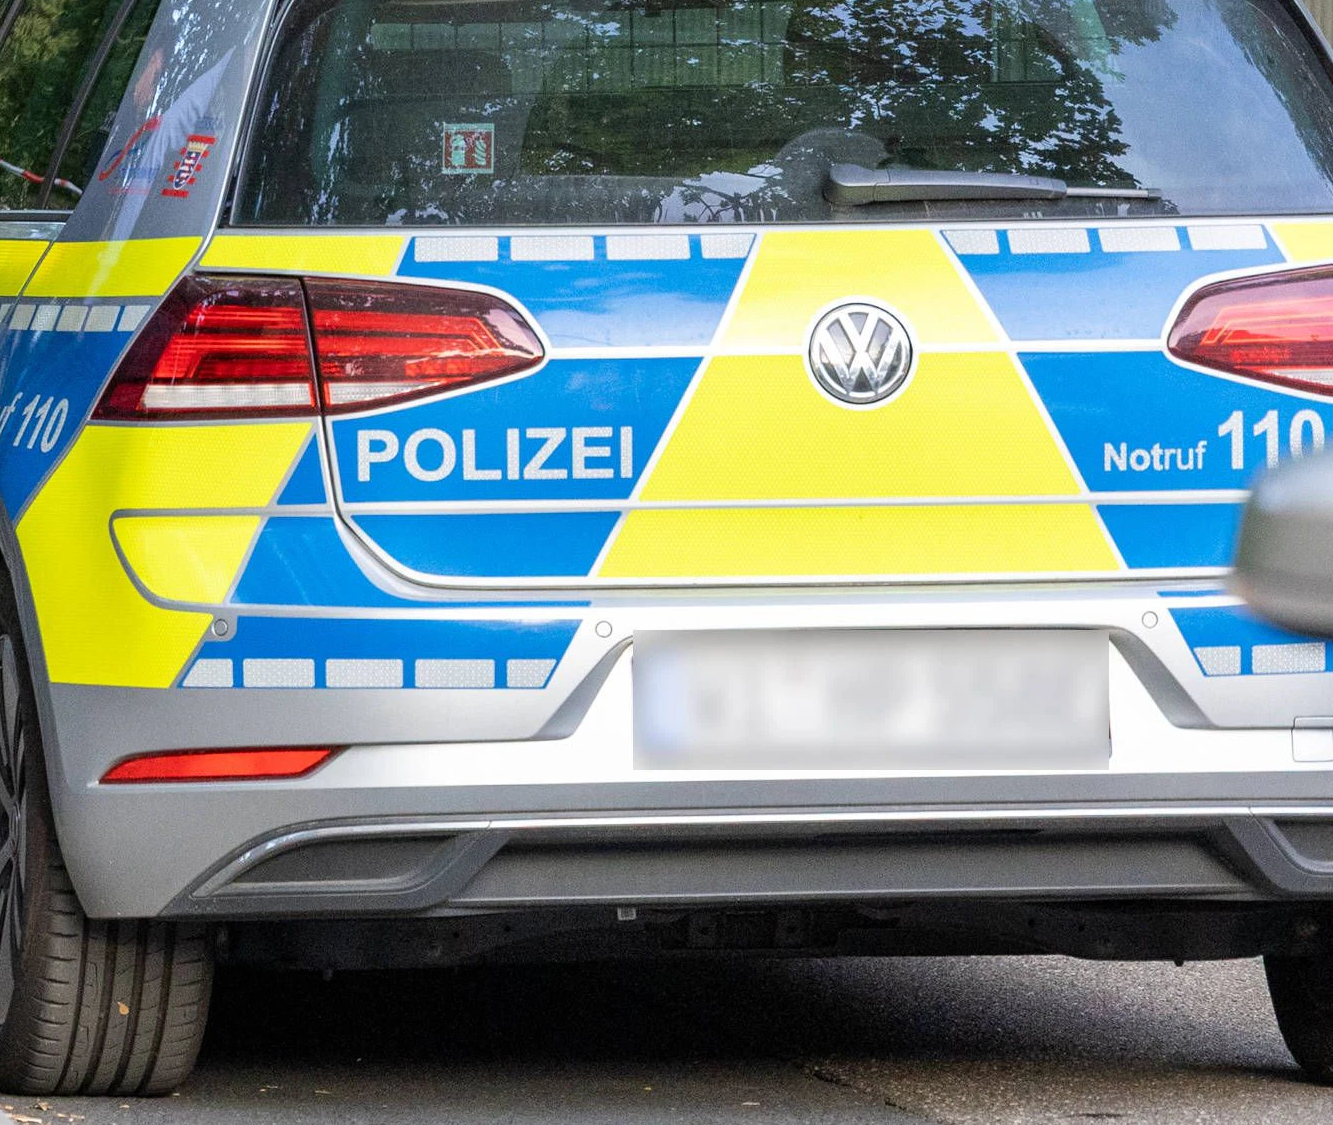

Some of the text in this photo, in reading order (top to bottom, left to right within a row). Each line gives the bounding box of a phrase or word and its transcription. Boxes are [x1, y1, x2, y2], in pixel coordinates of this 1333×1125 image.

[808, 302, 913, 405] VW
[13, 394, 69, 453] 110
[357, 426, 633, 482] POLIZEI
[1104, 409, 1325, 472] Notruf 110
